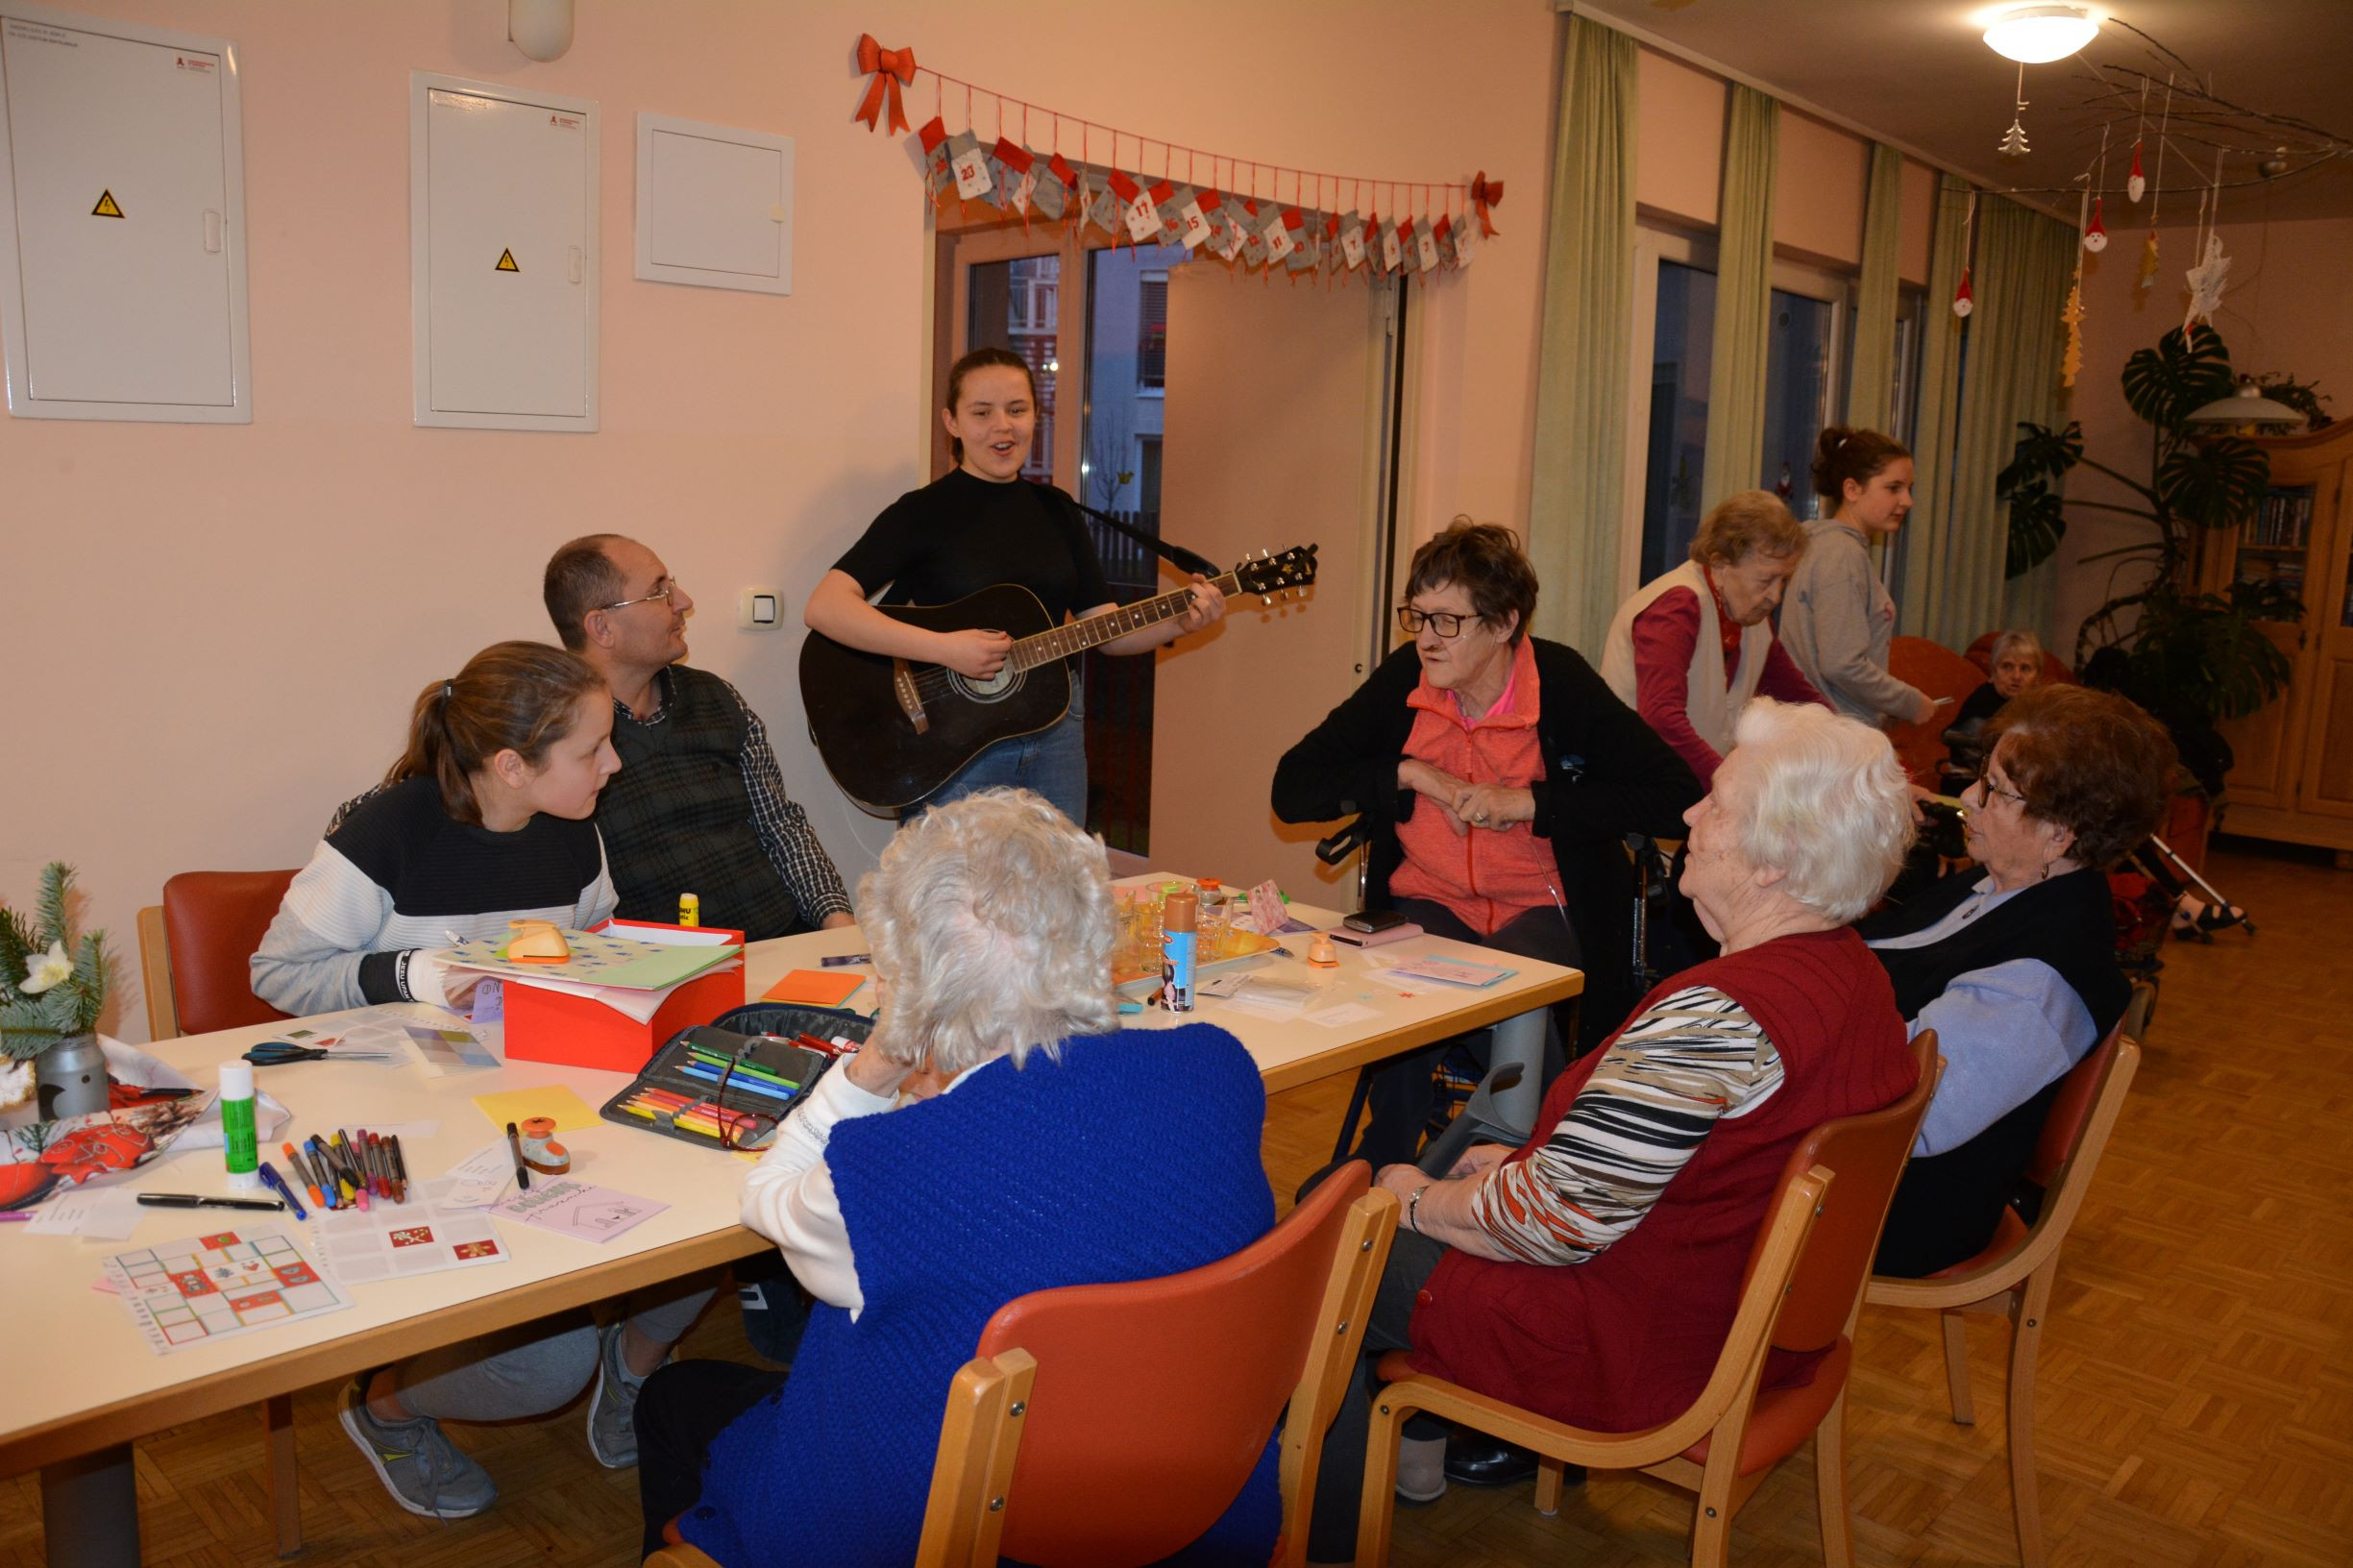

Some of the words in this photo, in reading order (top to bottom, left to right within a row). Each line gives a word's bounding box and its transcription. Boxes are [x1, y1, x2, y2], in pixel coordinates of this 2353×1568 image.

[962, 164, 975, 181] 23
[1136, 201, 1149, 217] 17
[1187, 216, 1200, 232] 15
